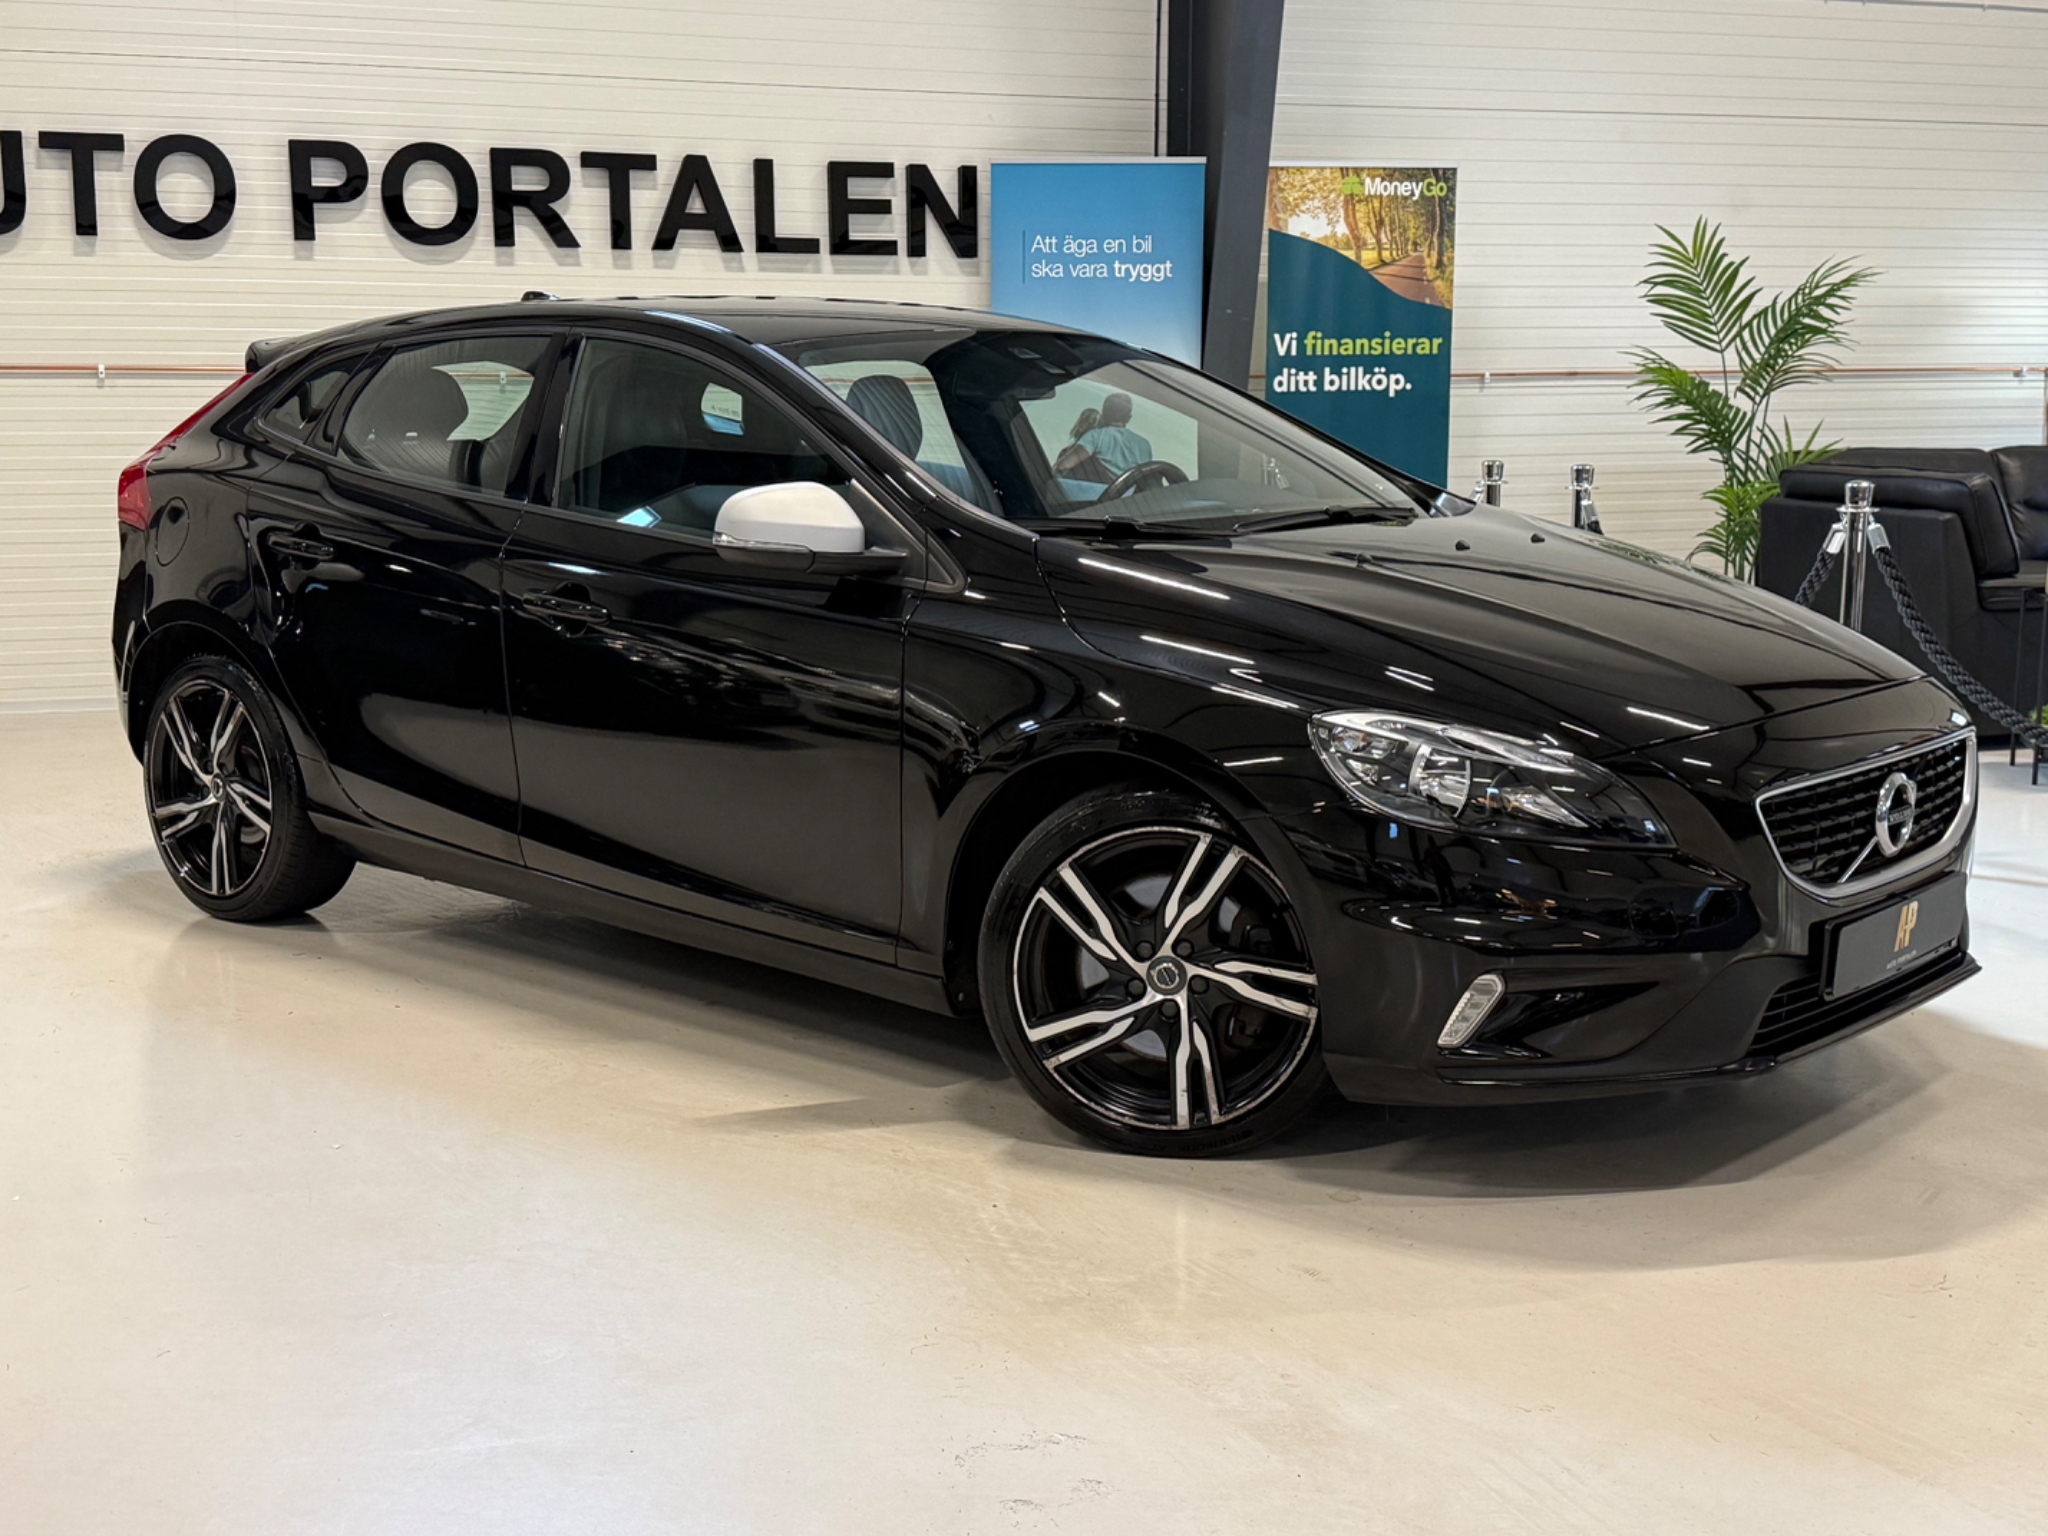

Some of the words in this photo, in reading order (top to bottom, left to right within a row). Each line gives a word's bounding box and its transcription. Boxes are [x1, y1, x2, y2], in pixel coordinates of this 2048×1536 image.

[287, 139, 978, 259] PORTALEN
[1364, 177, 1448, 200] MoneyGo
[1031, 235, 1058, 254] Att
[1063, 235, 1098, 258] äga
[1103, 238, 1127, 254] en
[1132, 235, 1153, 254] bil
[1031, 259, 1064, 278] ska
[1069, 262, 1109, 278] vara
[1114, 260, 1173, 282] tryggt
[1273, 332, 1298, 356] Vi
[1304, 331, 1443, 356] finansierar
[1272, 368, 1318, 393] ditt
[1323, 367, 1413, 398] bilköp.
